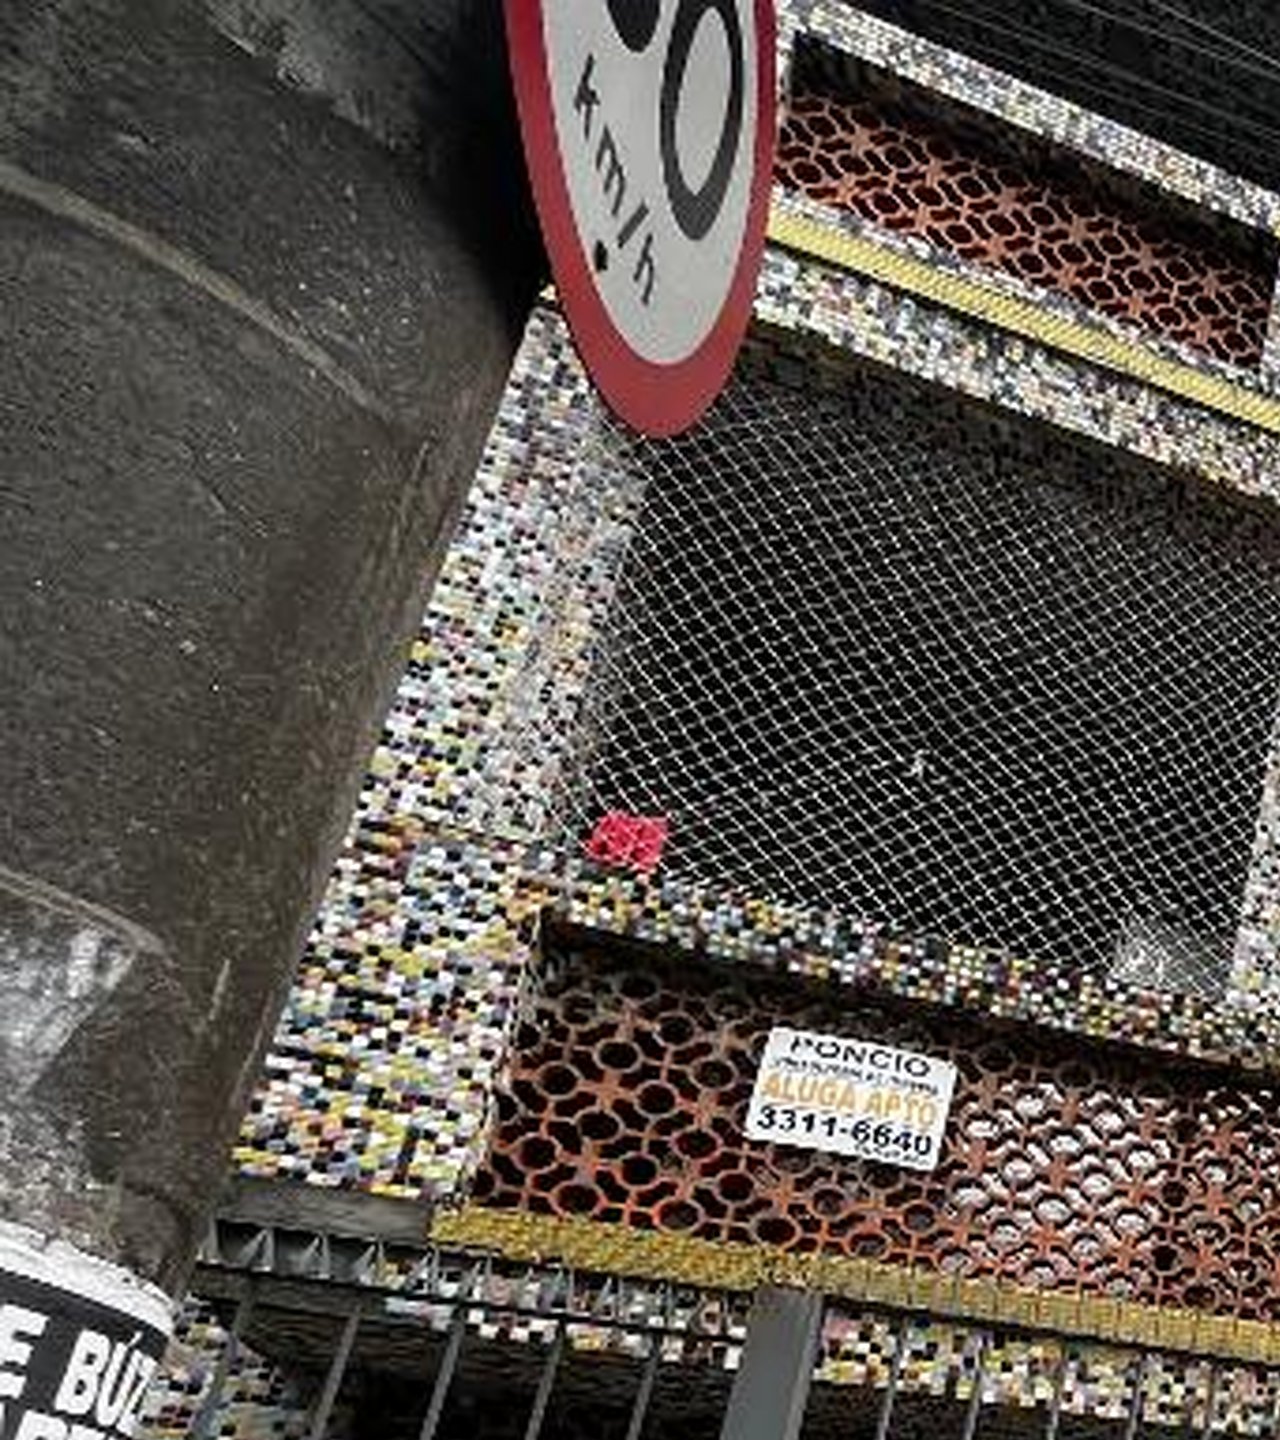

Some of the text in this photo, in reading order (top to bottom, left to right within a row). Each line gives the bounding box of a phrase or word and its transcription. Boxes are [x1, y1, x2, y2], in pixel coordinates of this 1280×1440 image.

[574, 53, 655, 305] km/h
[790, 1036, 931, 1078] PONCIO
[762, 1073, 855, 1113] ALUGA
[757, 1105, 932, 1156] 3311-6640
